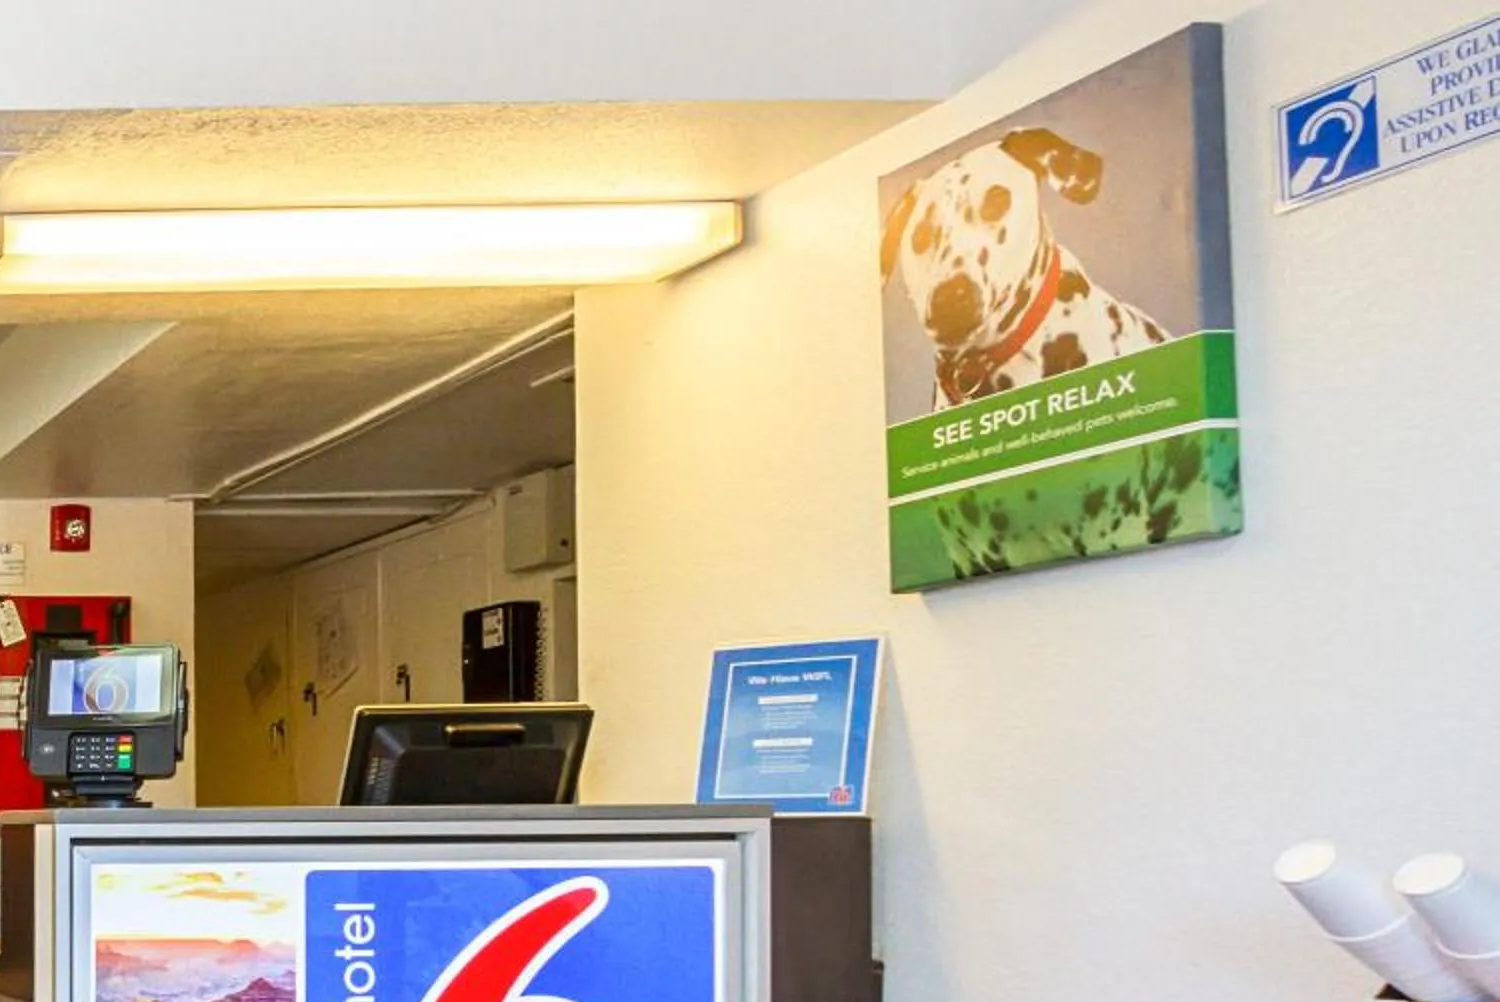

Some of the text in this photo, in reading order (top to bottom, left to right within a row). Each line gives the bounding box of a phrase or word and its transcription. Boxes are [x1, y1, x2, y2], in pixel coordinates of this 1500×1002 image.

[1417, 30, 1500, 74] WE GLA
[1431, 53, 1500, 96] PROVI
[1386, 87, 1482, 135] ASSISTIVE
[1401, 122, 1456, 153] UPON
[932, 370, 1136, 449] SEE SPOT RELAX
